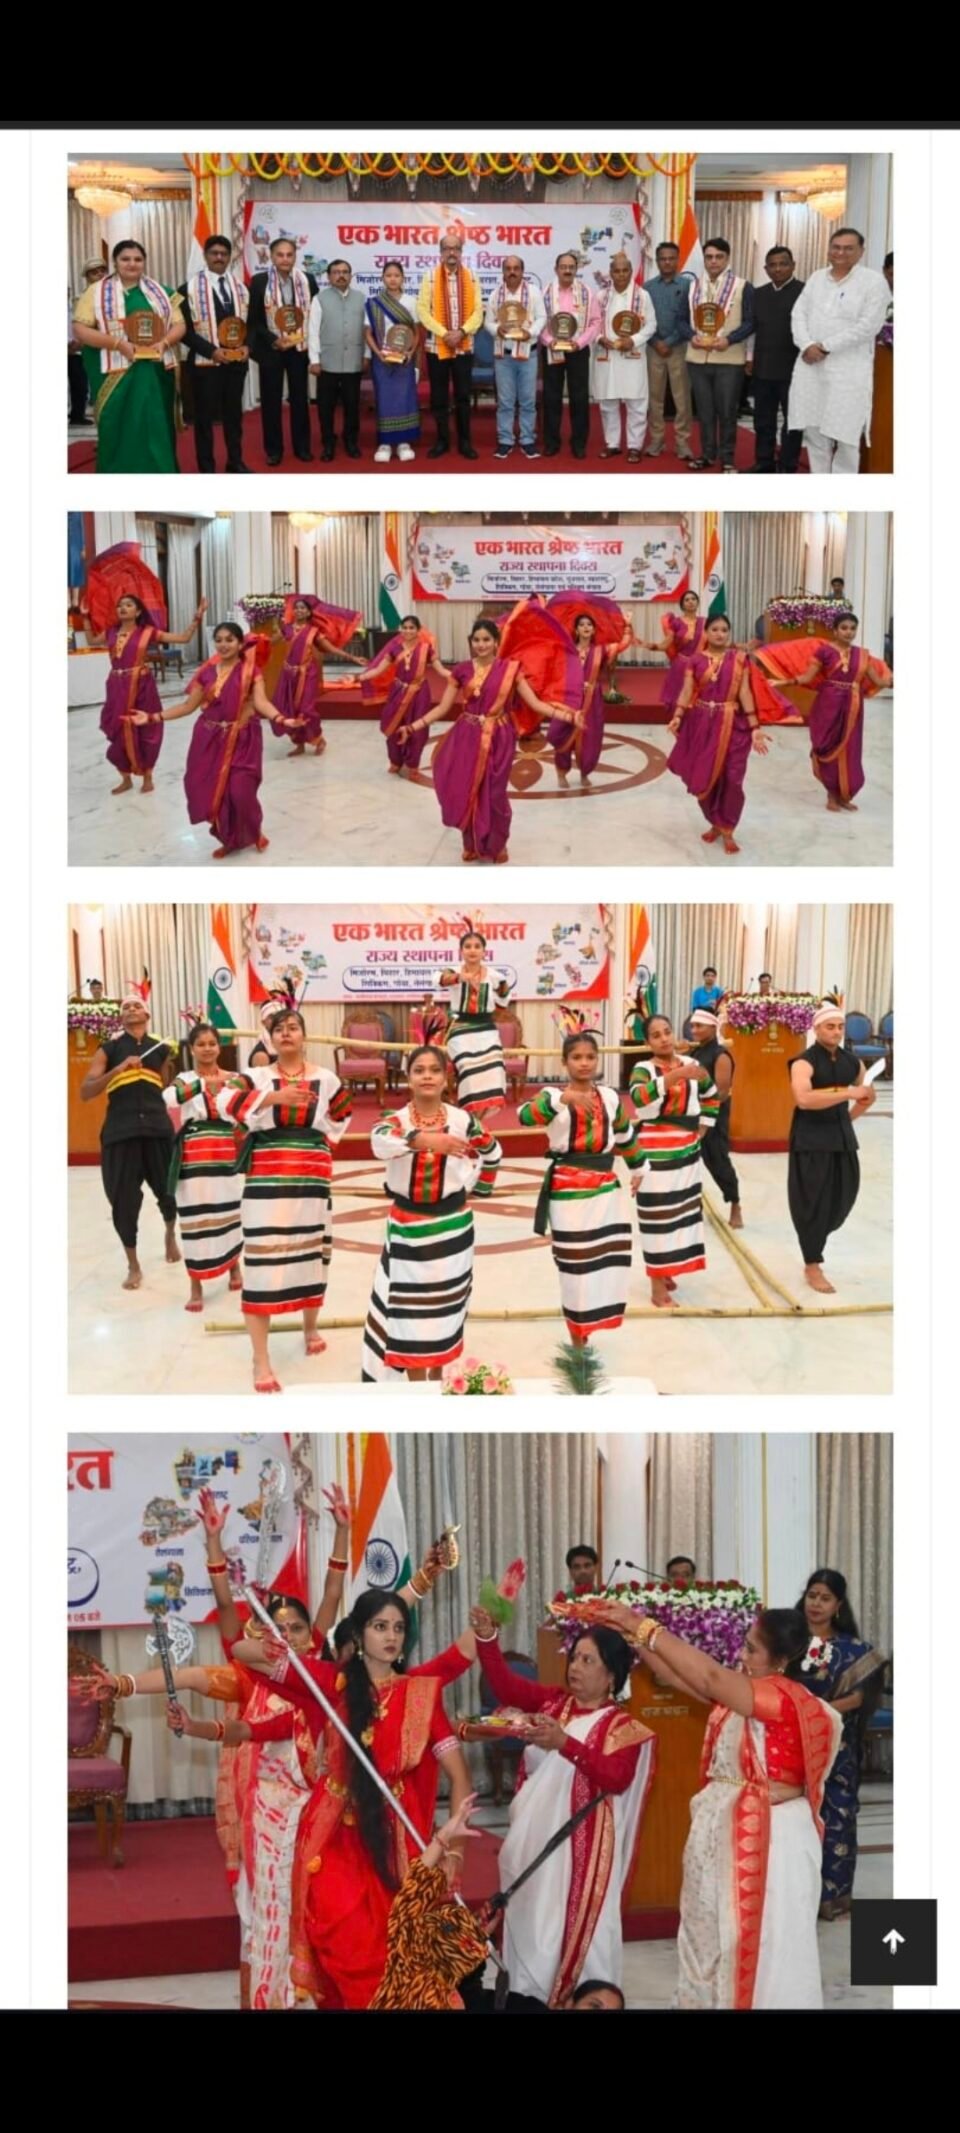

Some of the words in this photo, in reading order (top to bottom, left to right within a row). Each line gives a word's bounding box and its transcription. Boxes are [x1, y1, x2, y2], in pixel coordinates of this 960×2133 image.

[337, 225, 380, 245] एक
[384, 225, 440, 245] भारत
[496, 225, 553, 245] भारत
[477, 250, 506, 268] दिव
[475, 541, 502, 555] एक
[506, 541, 544, 555] भारत
[499, 561, 524, 571] राज्य
[527, 561, 566, 571] स्थापना
[570, 559, 598, 571] दिवस
[332, 923, 371, 941] एक
[374, 923, 425, 941] भारत
[366, 950, 398, 962] राज्य
[402, 950, 453, 962] स्थापना
